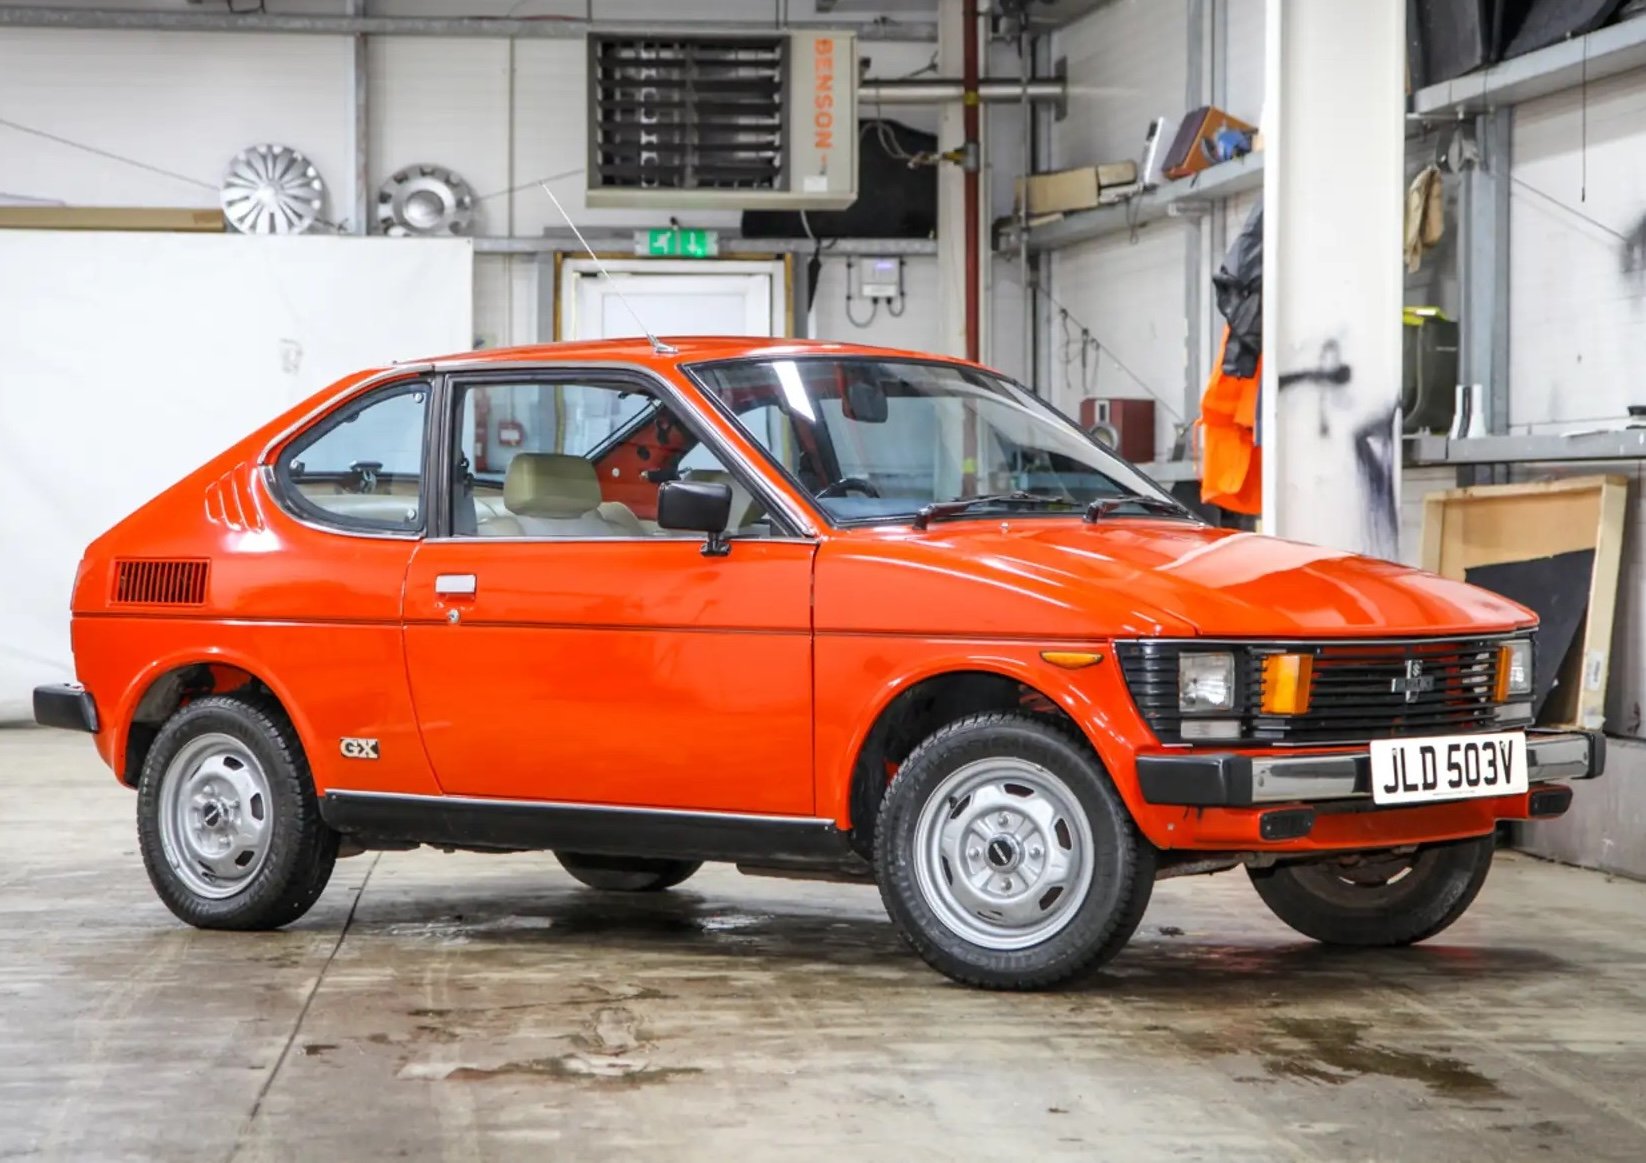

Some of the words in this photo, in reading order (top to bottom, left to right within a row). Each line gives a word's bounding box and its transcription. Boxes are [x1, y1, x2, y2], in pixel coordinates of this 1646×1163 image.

[814, 38, 833, 149] BENSON
[340, 738, 378, 759] GX
[1383, 745, 1438, 794] JLD
[1447, 739, 1513, 789] 503V
